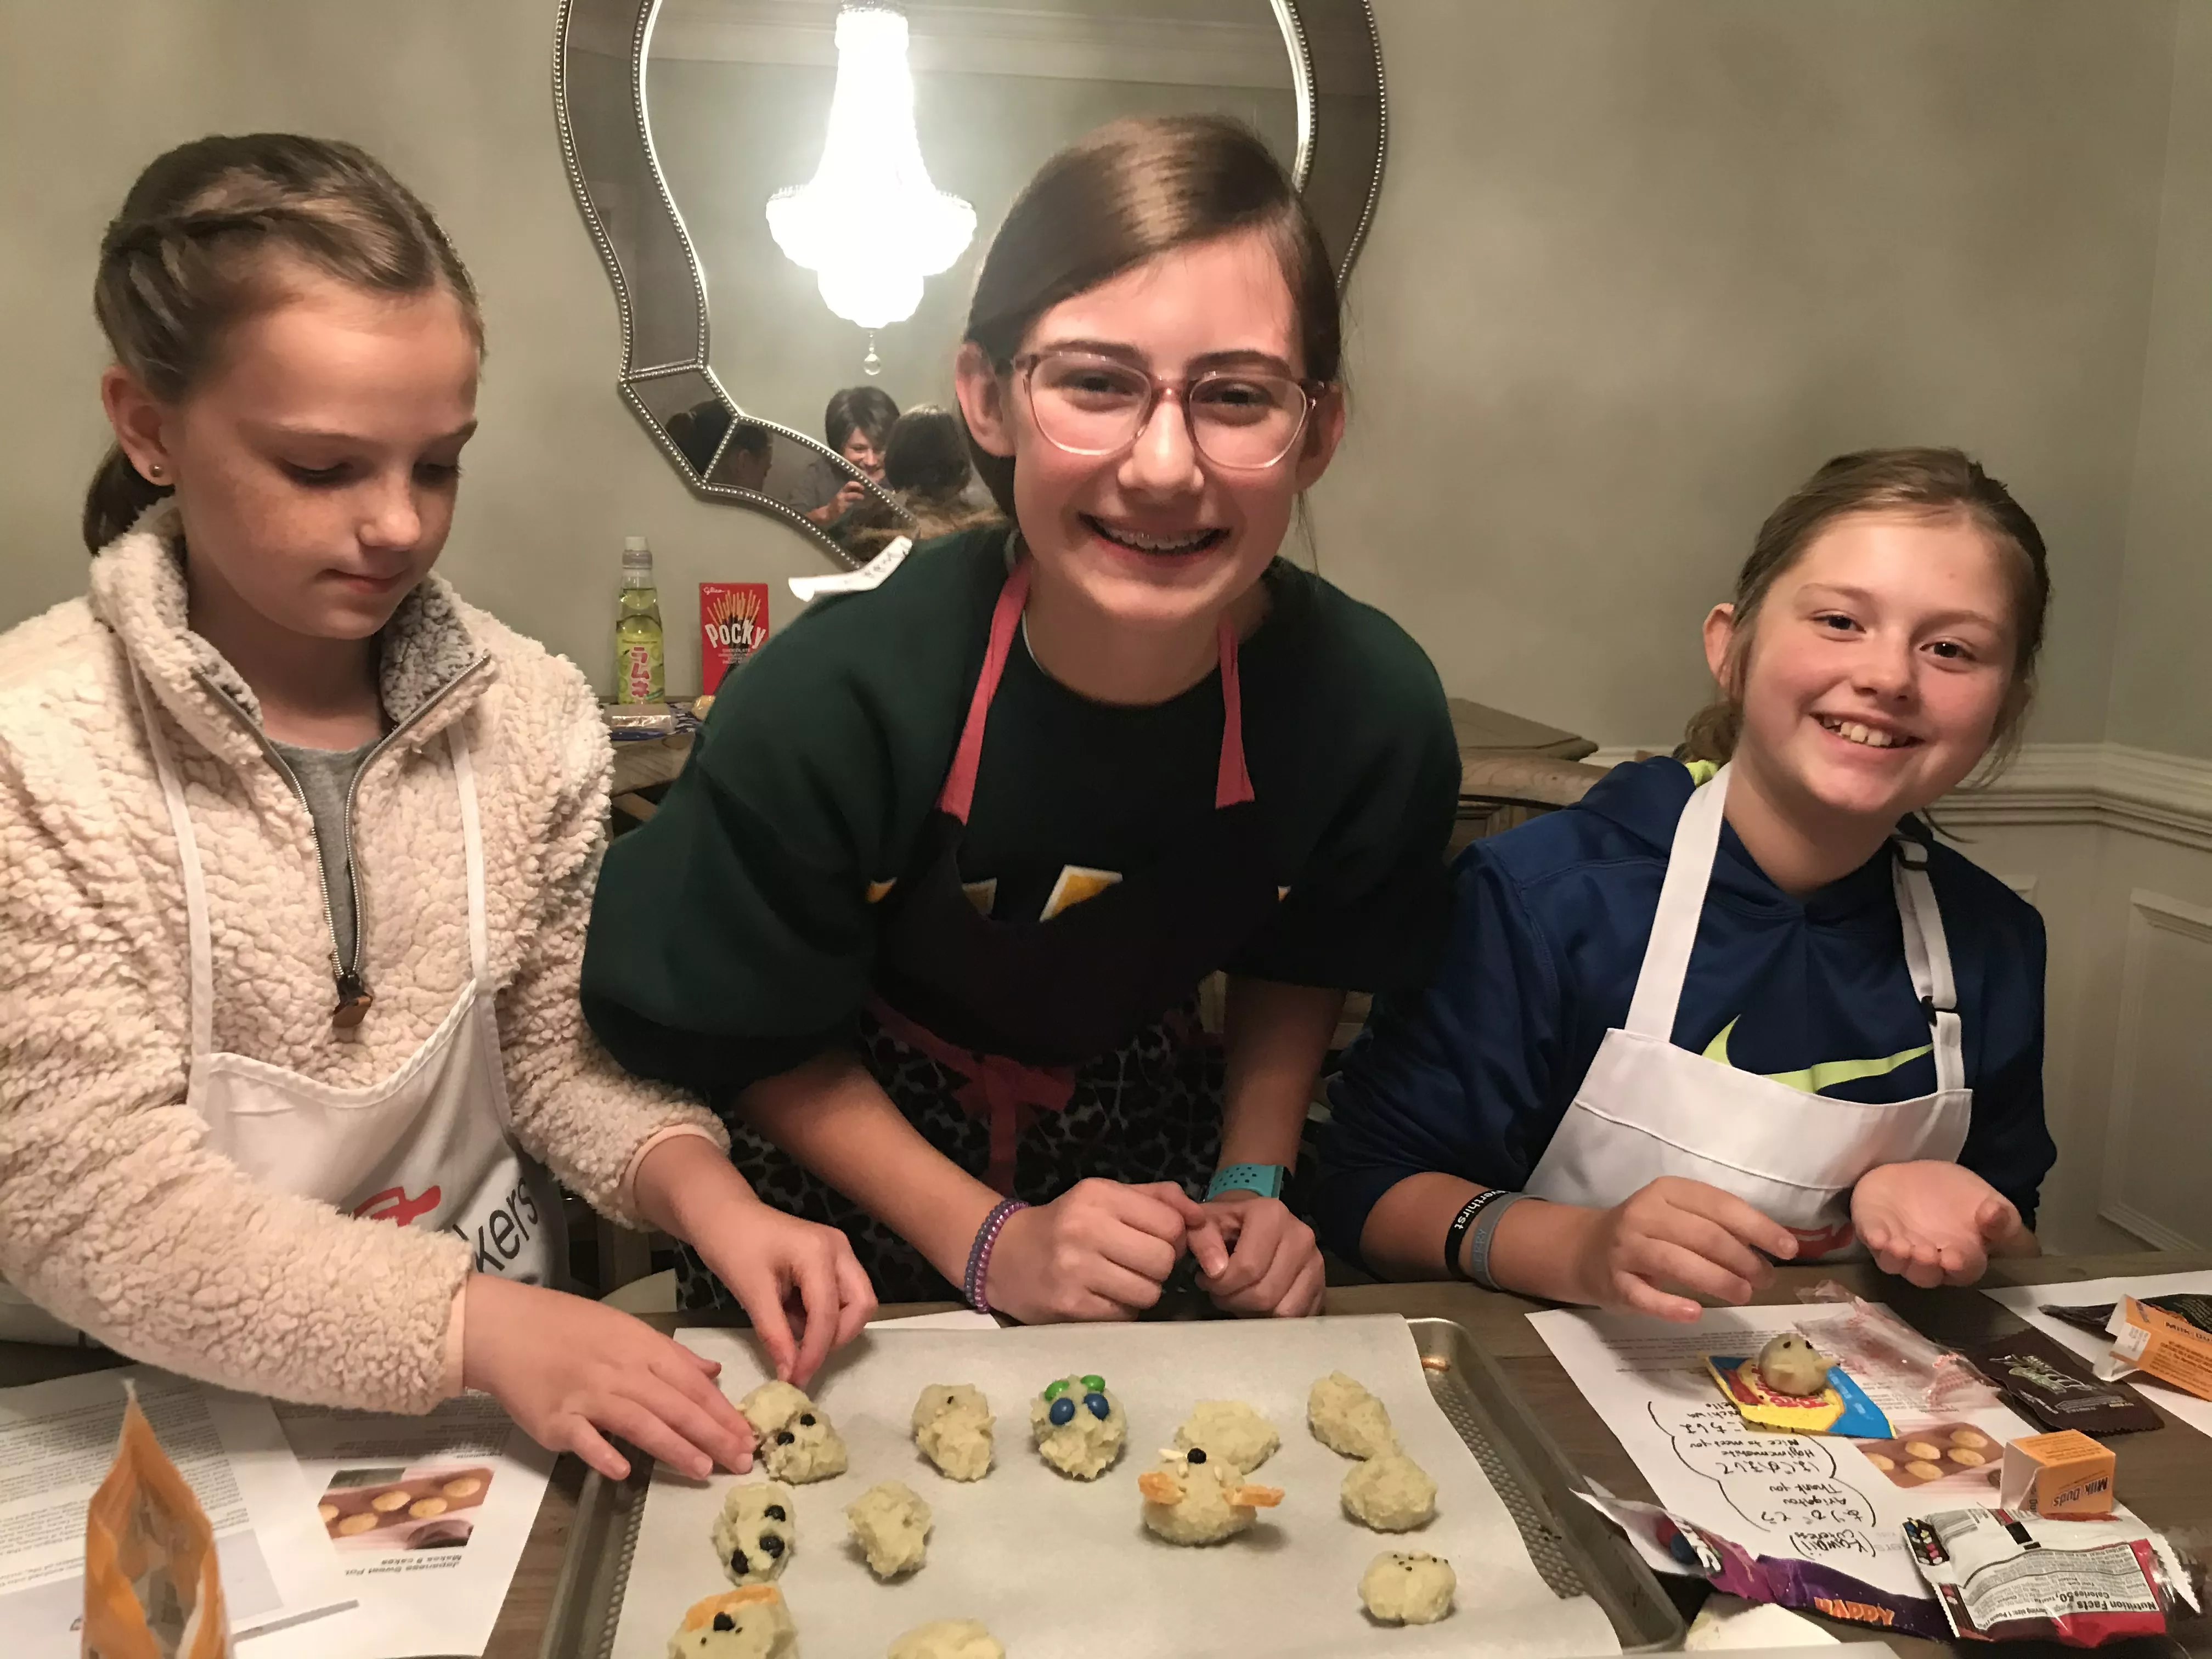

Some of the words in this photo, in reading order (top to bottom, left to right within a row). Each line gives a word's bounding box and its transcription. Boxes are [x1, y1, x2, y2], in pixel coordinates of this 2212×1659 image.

[704, 619, 766, 650] POCKY
[631, 646, 650, 697] ラムネ
[1690, 1438, 1712, 1448] you
[1747, 1439, 1763, 1448] to
[1768, 1483, 1793, 1493] you
[1795, 1484, 1842, 1495] Thank
[2084, 1476, 2108, 1497] Milk
[2052, 1487, 2081, 1508] Duds
[368, 1566, 402, 1575] Sweet
[405, 1561, 460, 1572] Japanese
[2074, 1590, 2110, 1600] Calories
[2076, 1600, 2108, 1611] Facts
[2109, 1600, 2157, 1612] Nutrition
